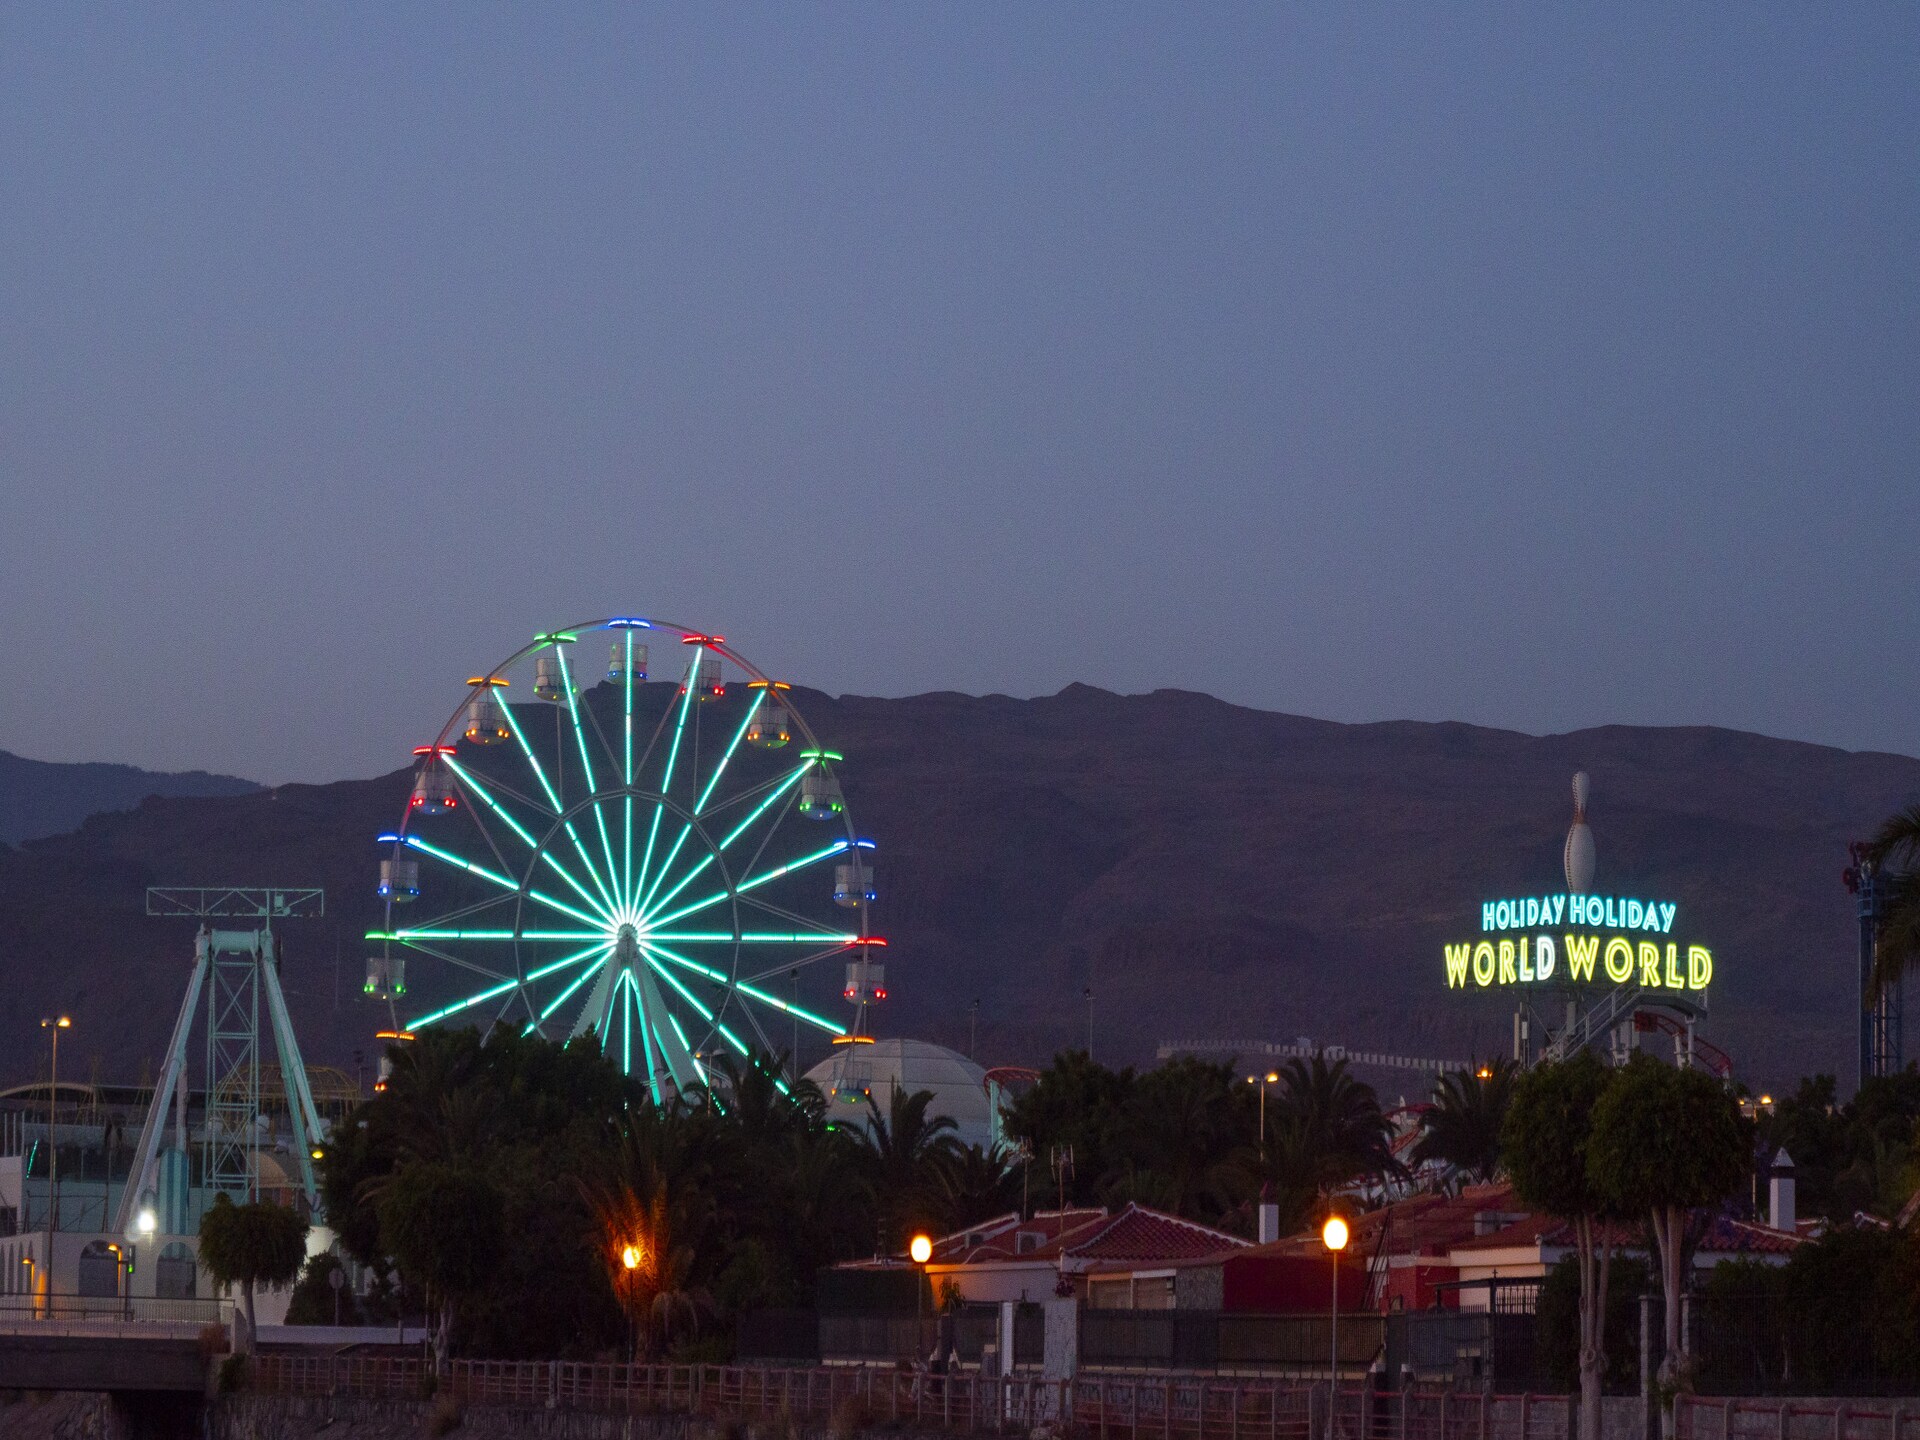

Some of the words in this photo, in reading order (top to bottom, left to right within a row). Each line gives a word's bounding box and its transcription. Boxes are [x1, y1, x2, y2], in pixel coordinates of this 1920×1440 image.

[1483, 895, 1566, 931] HOLIDAY
[1570, 895, 1676, 933] HOLIDAY
[1445, 936, 1556, 989] WORLD
[1565, 934, 1713, 990] WORLD
